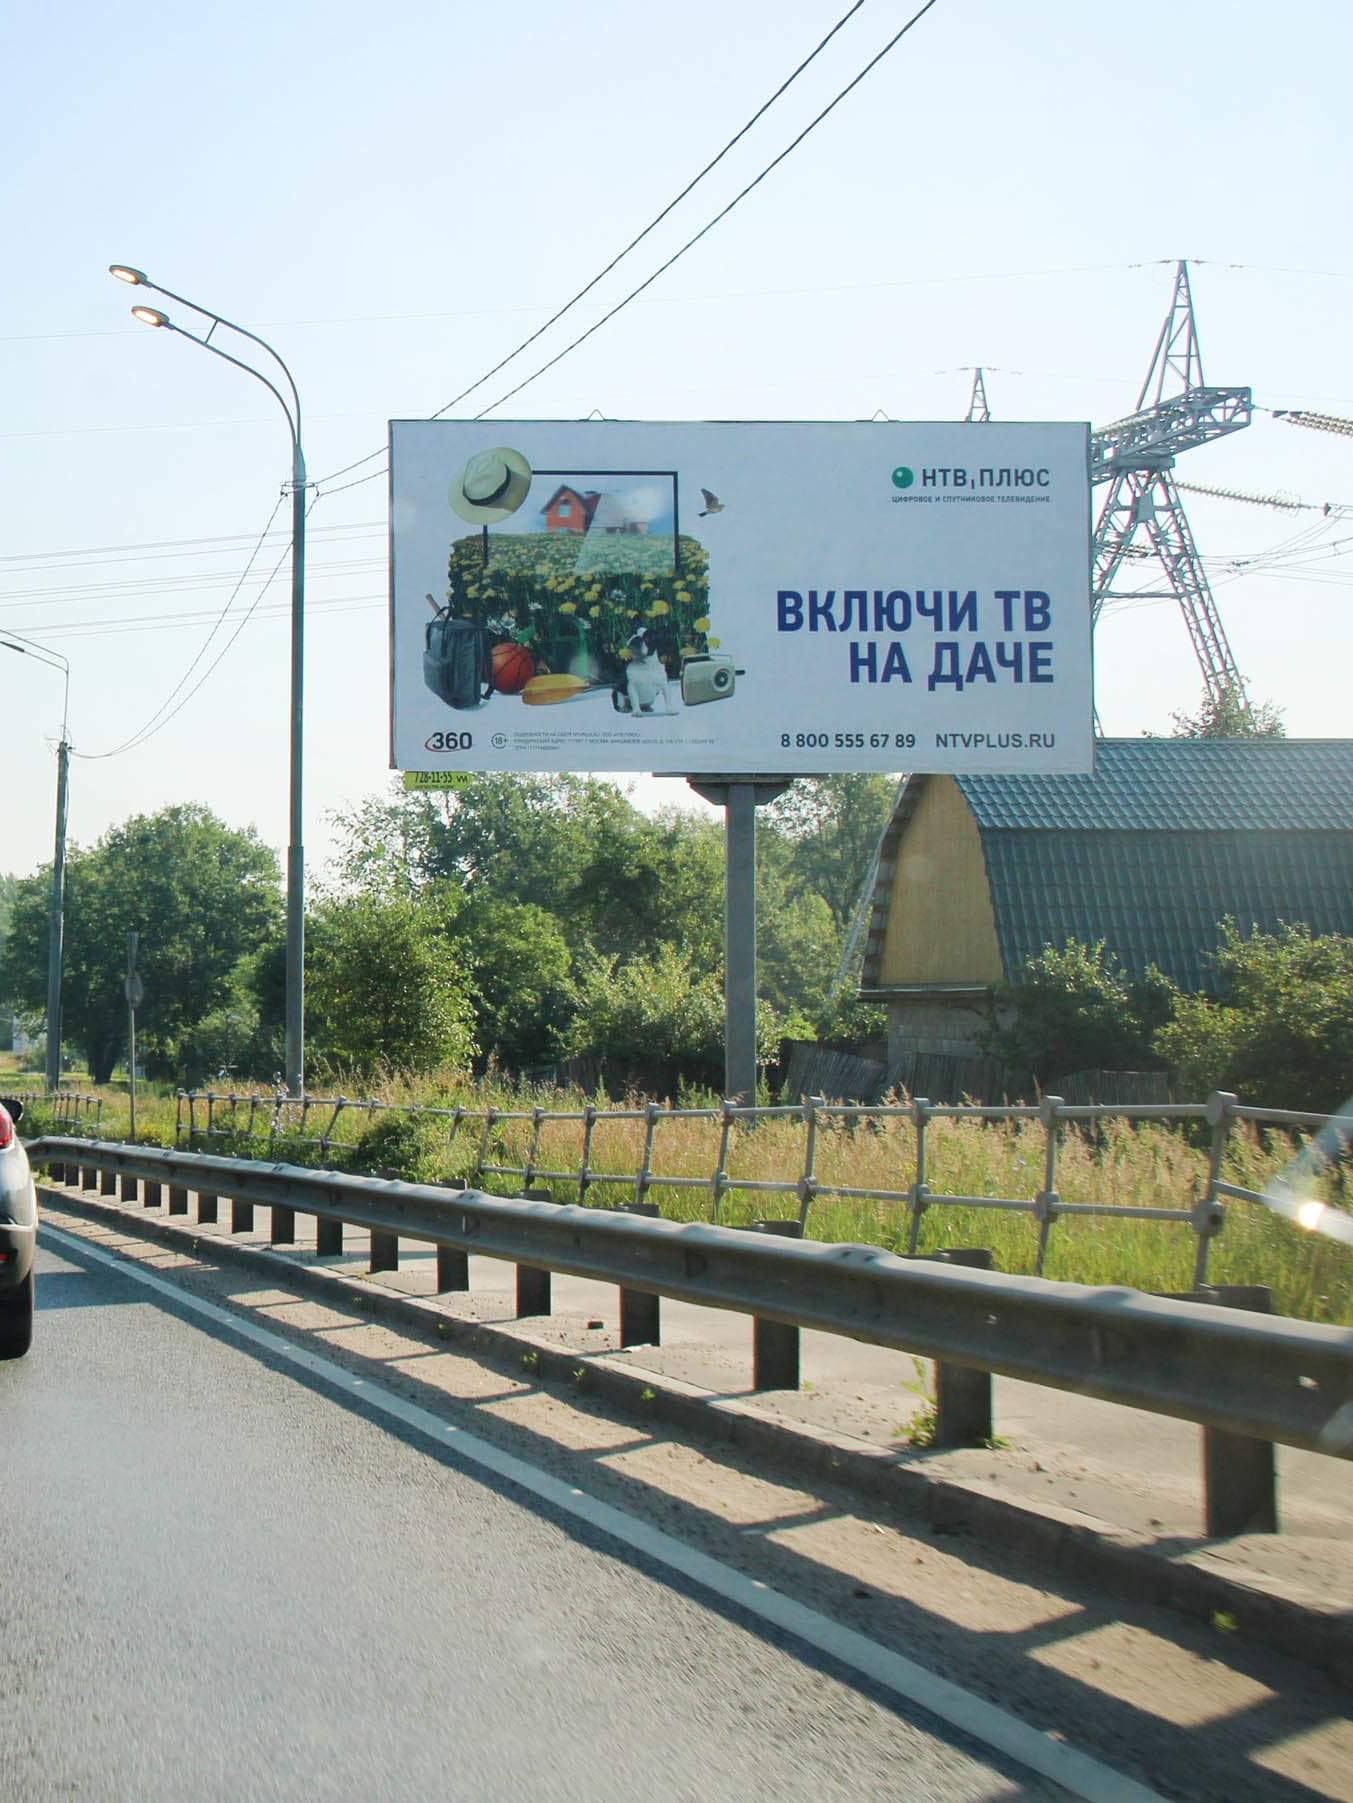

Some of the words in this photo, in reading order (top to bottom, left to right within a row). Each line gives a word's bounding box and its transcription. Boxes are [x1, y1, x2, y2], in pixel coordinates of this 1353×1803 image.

[892, 495, 933, 504] ЦИФРОВОЕ
[935, 495, 940, 503] И
[998, 495, 1051, 504] ТЕЛЕВИДЕНИЕ
[776, 590, 978, 632] ВКЛЮЧИ
[994, 590, 1052, 632] ТВ
[849, 641, 913, 684] НА
[927, 641, 1054, 692] ДАЧЕ
[432, 731, 473, 750] 360
[780, 733, 791, 748] 8
[796, 733, 829, 748] 800
[834, 733, 865, 748] 555
[869, 733, 889, 748] 67
[894, 733, 916, 748] 89
[935, 733, 1056, 749] NTVPLUS.RU
